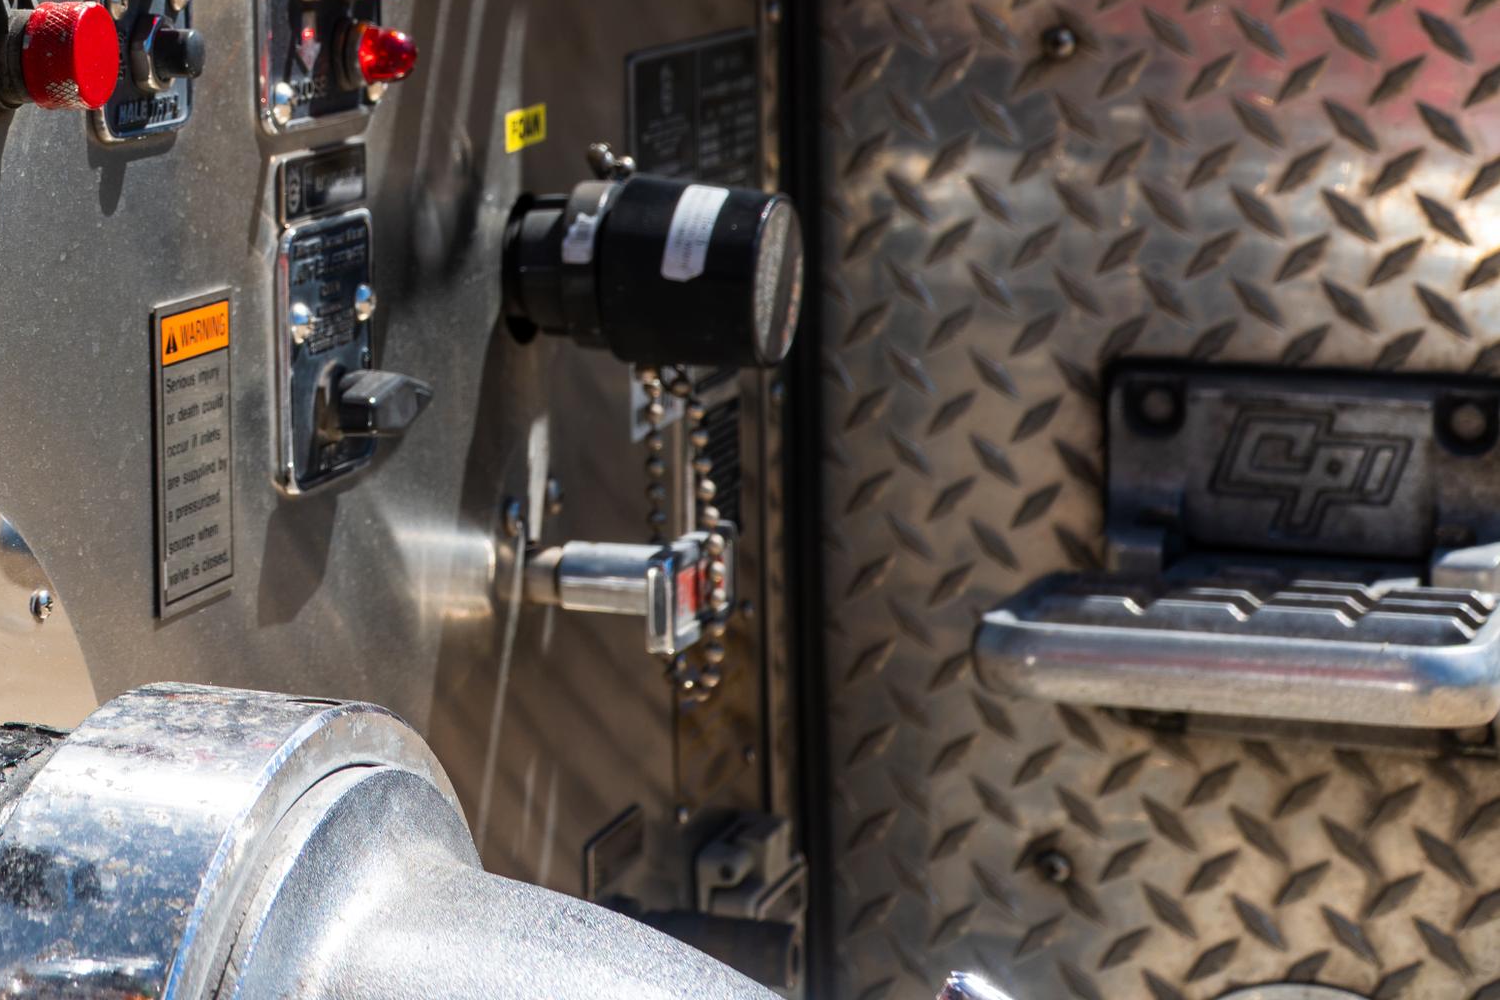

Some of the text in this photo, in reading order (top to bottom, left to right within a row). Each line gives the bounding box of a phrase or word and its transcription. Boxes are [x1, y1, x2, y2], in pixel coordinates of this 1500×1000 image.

[118, 101, 148, 123] HALE
[179, 313, 225, 347] WARNING
[166, 367, 221, 394] Serious injury
[166, 393, 224, 426] or death could
[167, 475, 181, 490] are
[218, 458, 228, 473] by
[168, 523, 219, 556] source when
[168, 551, 229, 587] valve is closed
